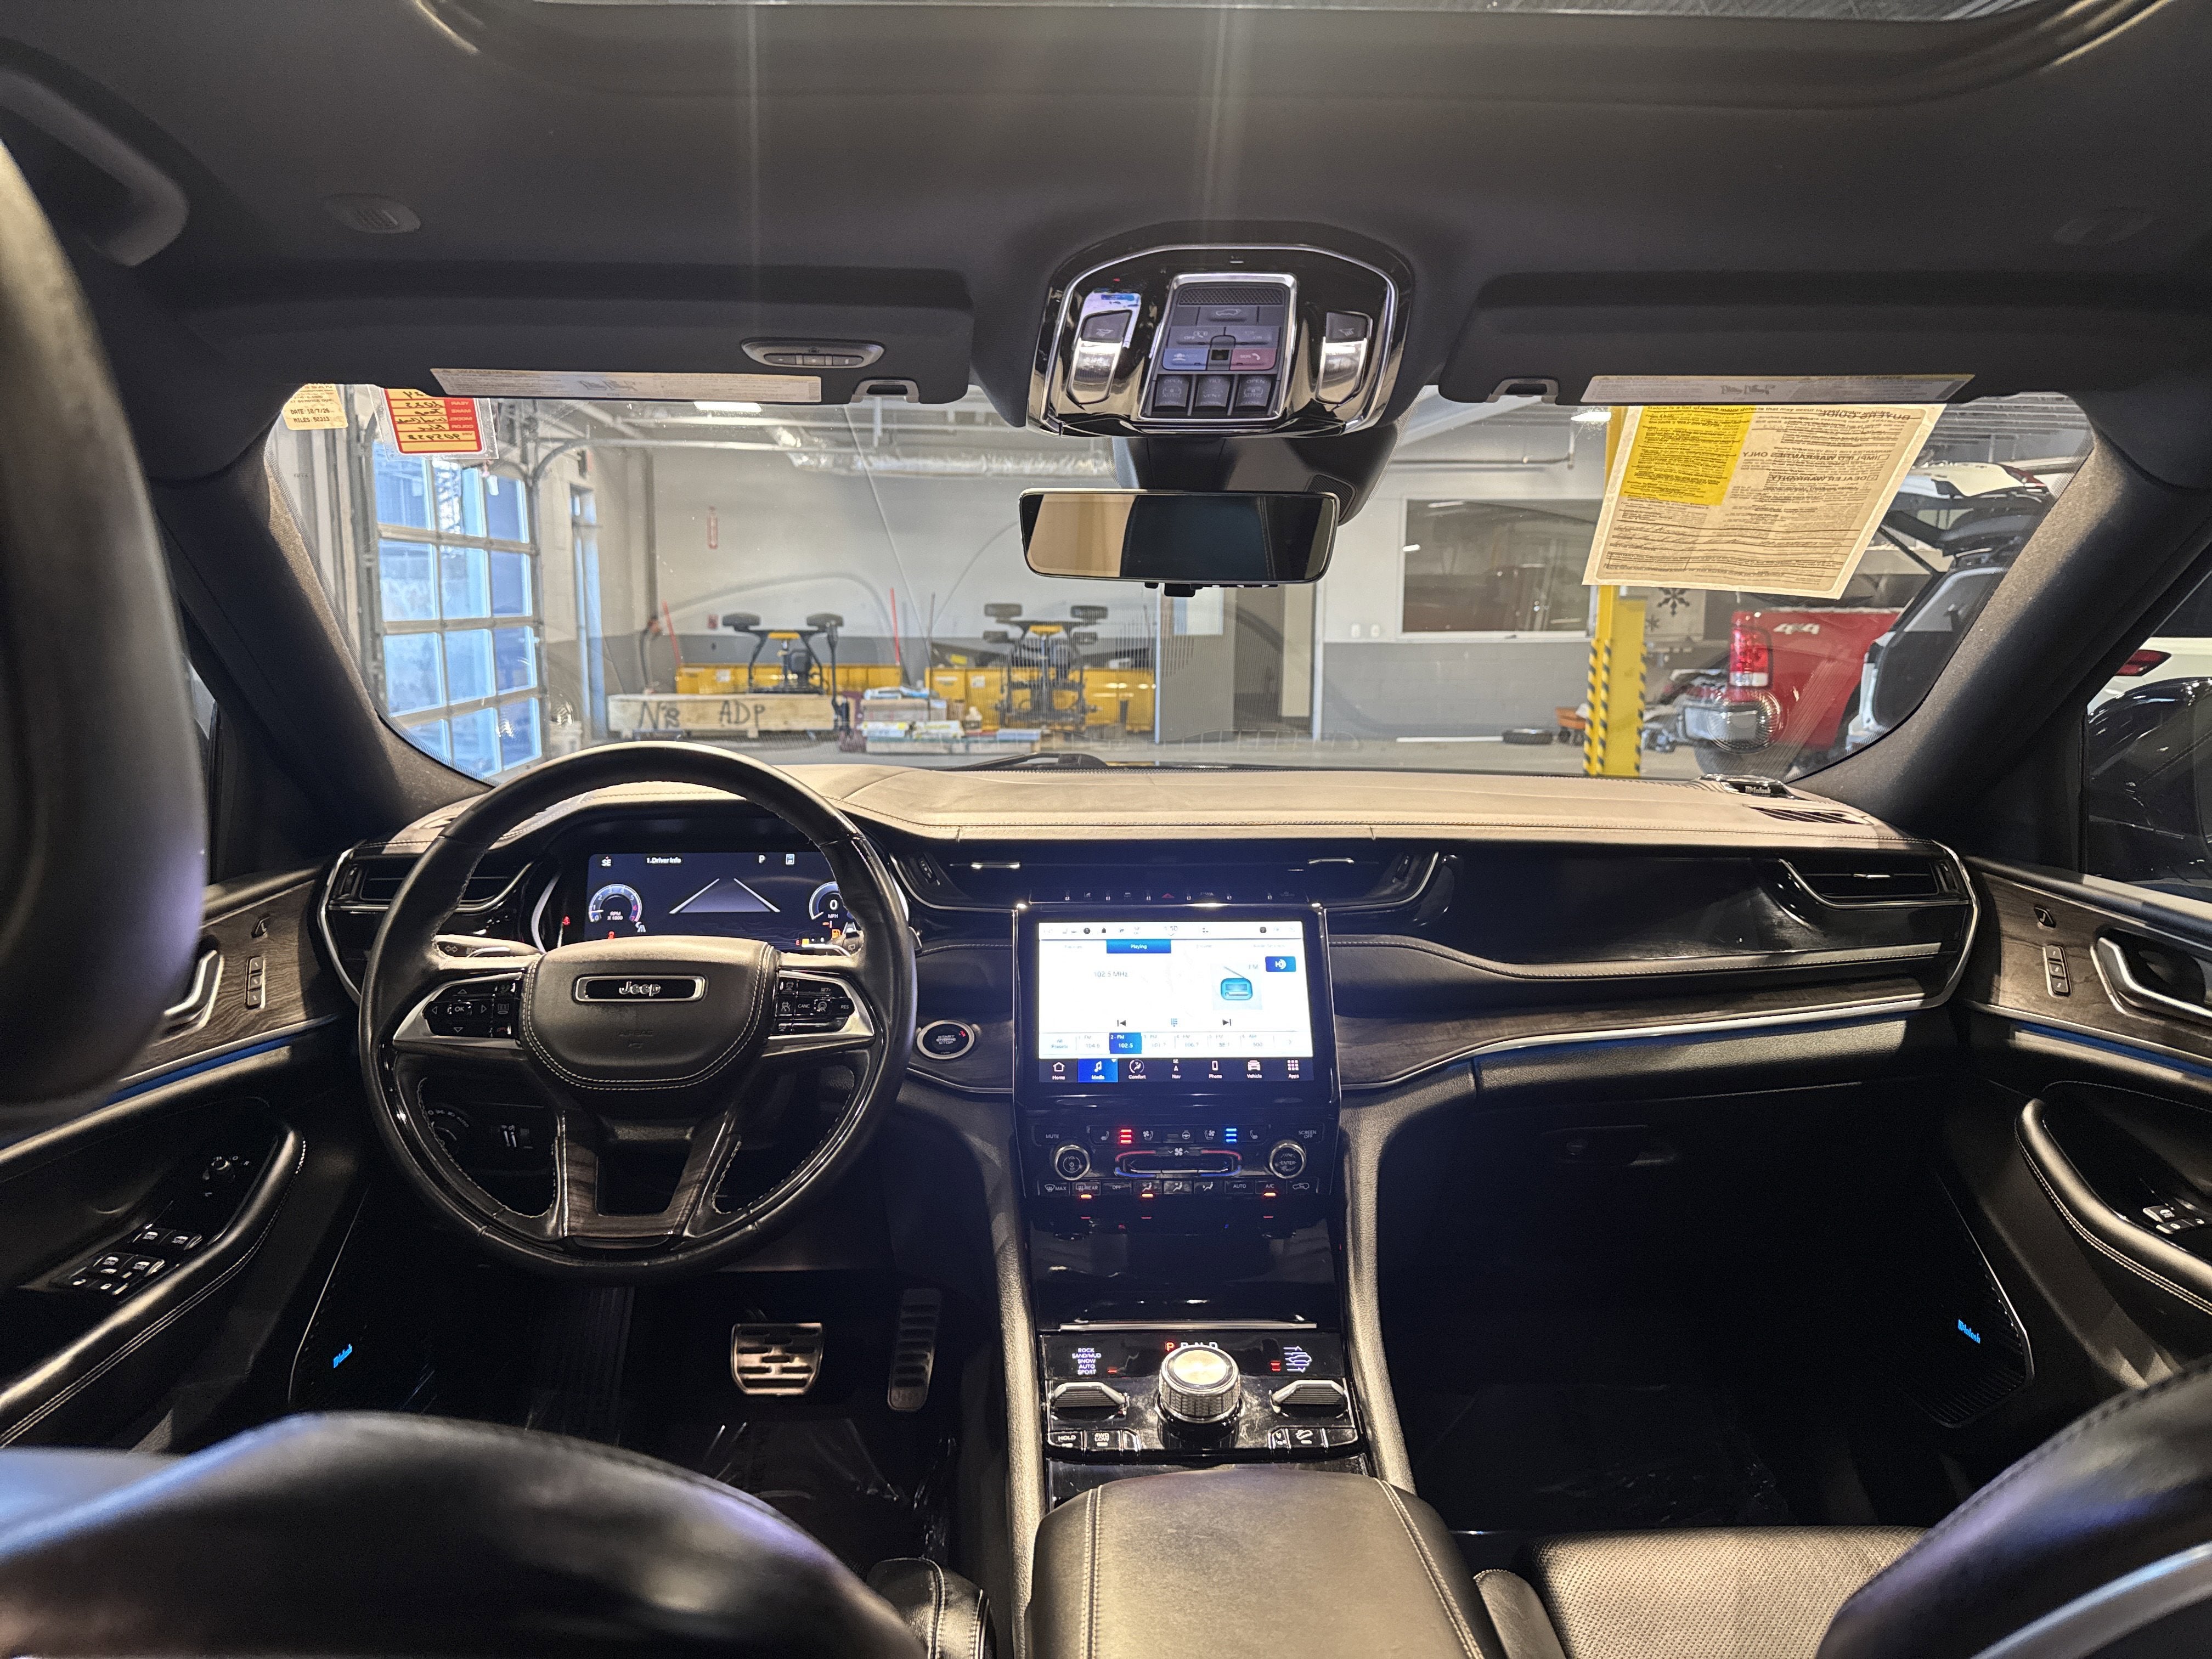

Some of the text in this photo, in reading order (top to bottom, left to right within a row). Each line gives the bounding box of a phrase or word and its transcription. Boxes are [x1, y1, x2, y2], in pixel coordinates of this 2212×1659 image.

[758, 855, 766, 864] P
[829, 899, 838, 911] 0
[619, 981, 661, 997] Jeep
[1166, 1342, 1175, 1352] P
